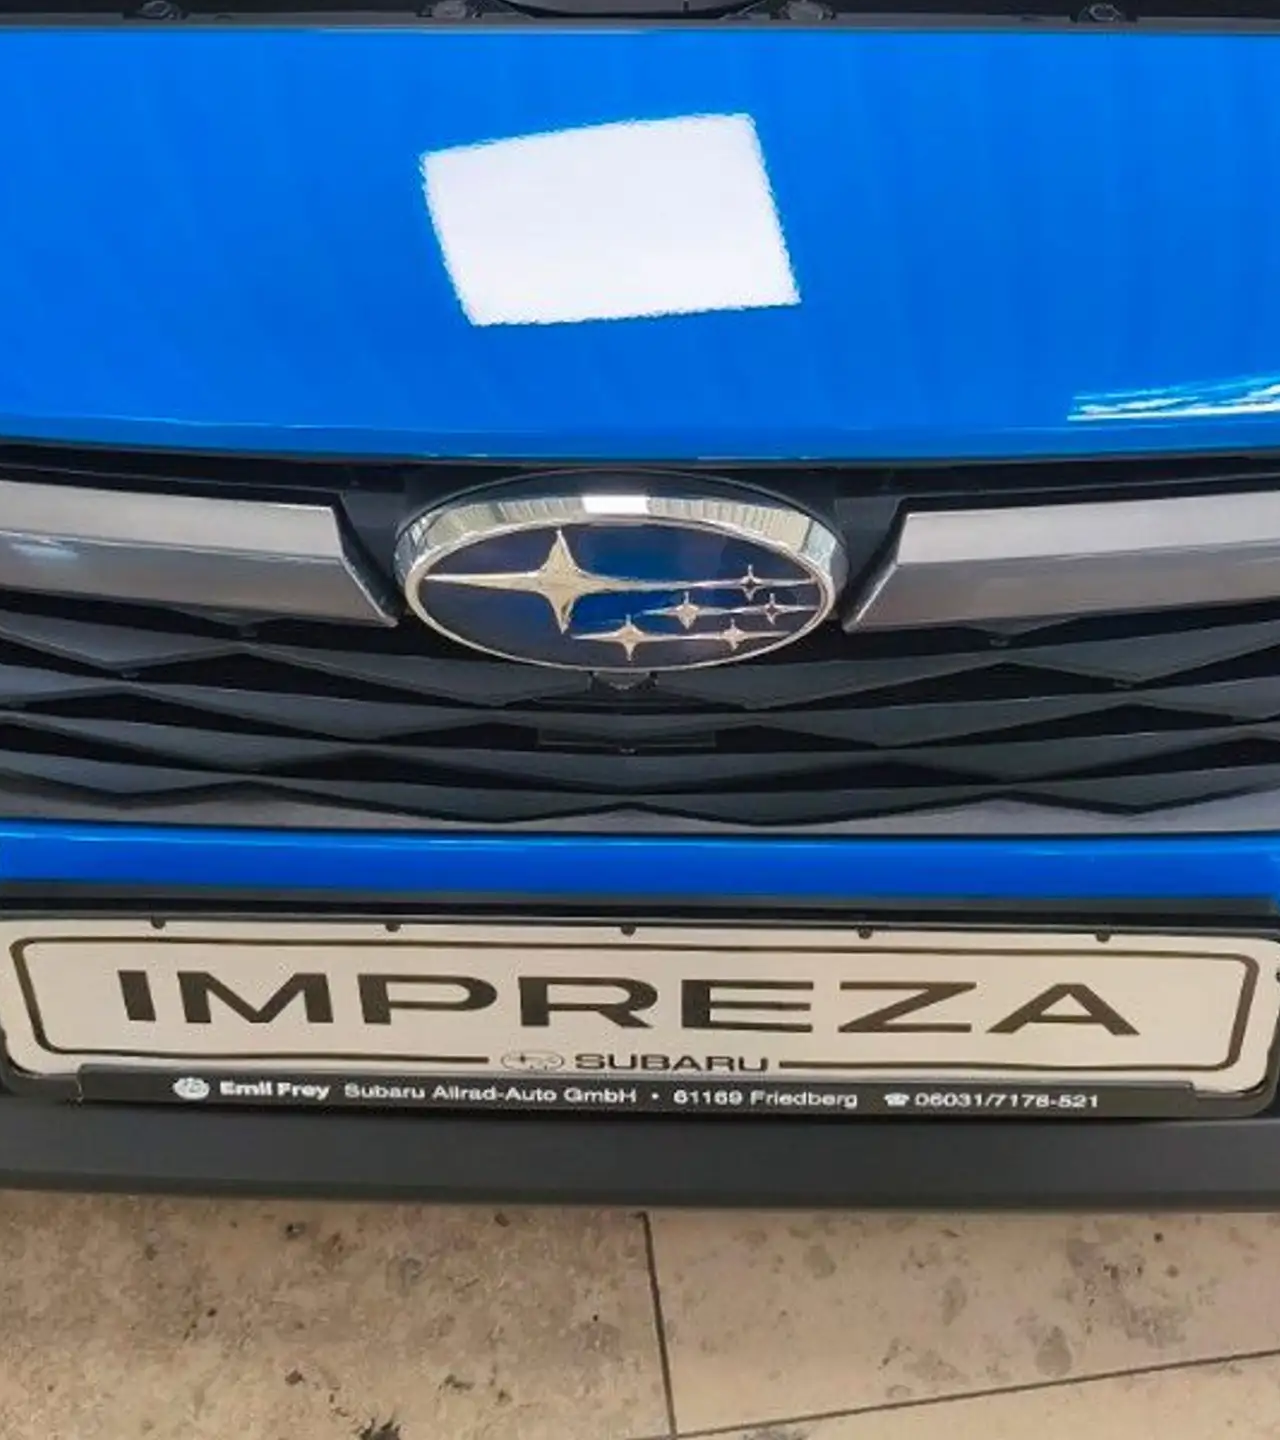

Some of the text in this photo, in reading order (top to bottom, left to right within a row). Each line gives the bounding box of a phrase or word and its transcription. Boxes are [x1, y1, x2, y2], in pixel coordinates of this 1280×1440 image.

[117, 968, 1140, 1036] IMPREZA
[575, 1052, 768, 1072] SUBARU
[219, 1080, 273, 1097] Emil
[276, 1080, 331, 1101] Frey
[343, 1080, 426, 1099] Subaru
[431, 1082, 557, 1102] Allrad-Auto
[563, 1087, 637, 1104] GmbH
[673, 1088, 743, 1106] 61169
[749, 1089, 859, 1109] Friedberg
